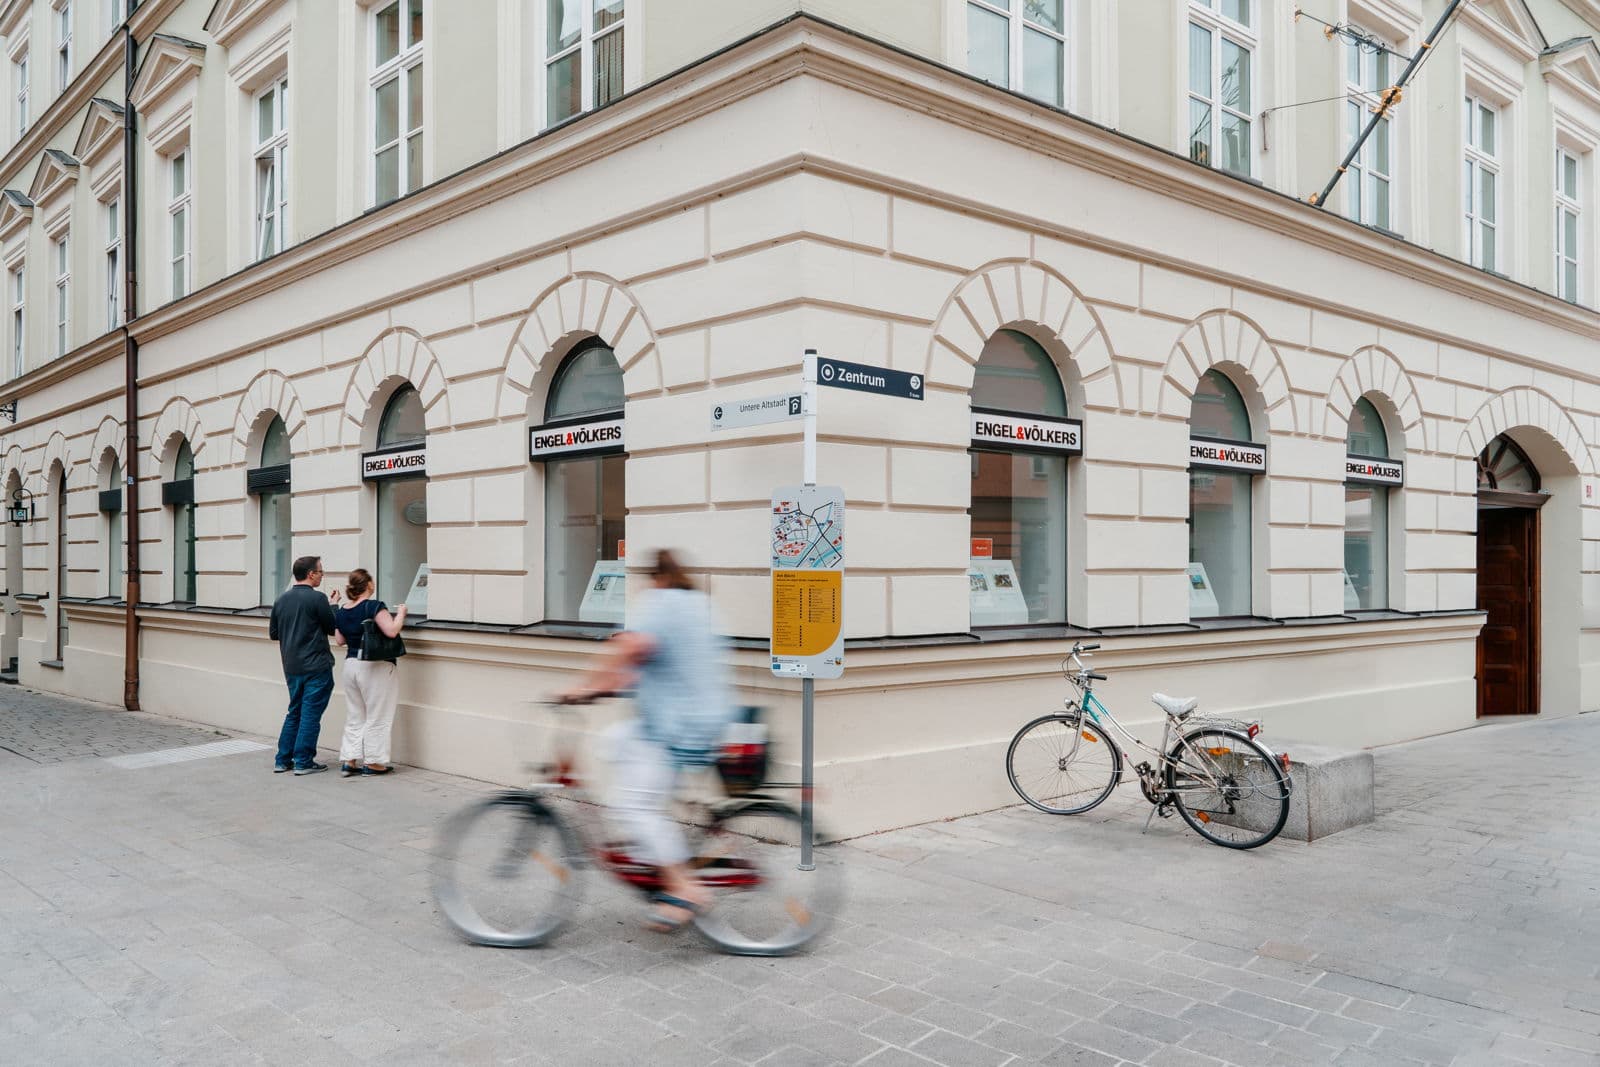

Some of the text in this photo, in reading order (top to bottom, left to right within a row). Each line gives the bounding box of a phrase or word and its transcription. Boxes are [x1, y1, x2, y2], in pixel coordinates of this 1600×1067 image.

[837, 367, 886, 388] Zentrum
[739, 399, 787, 413] Untere Altstadt
